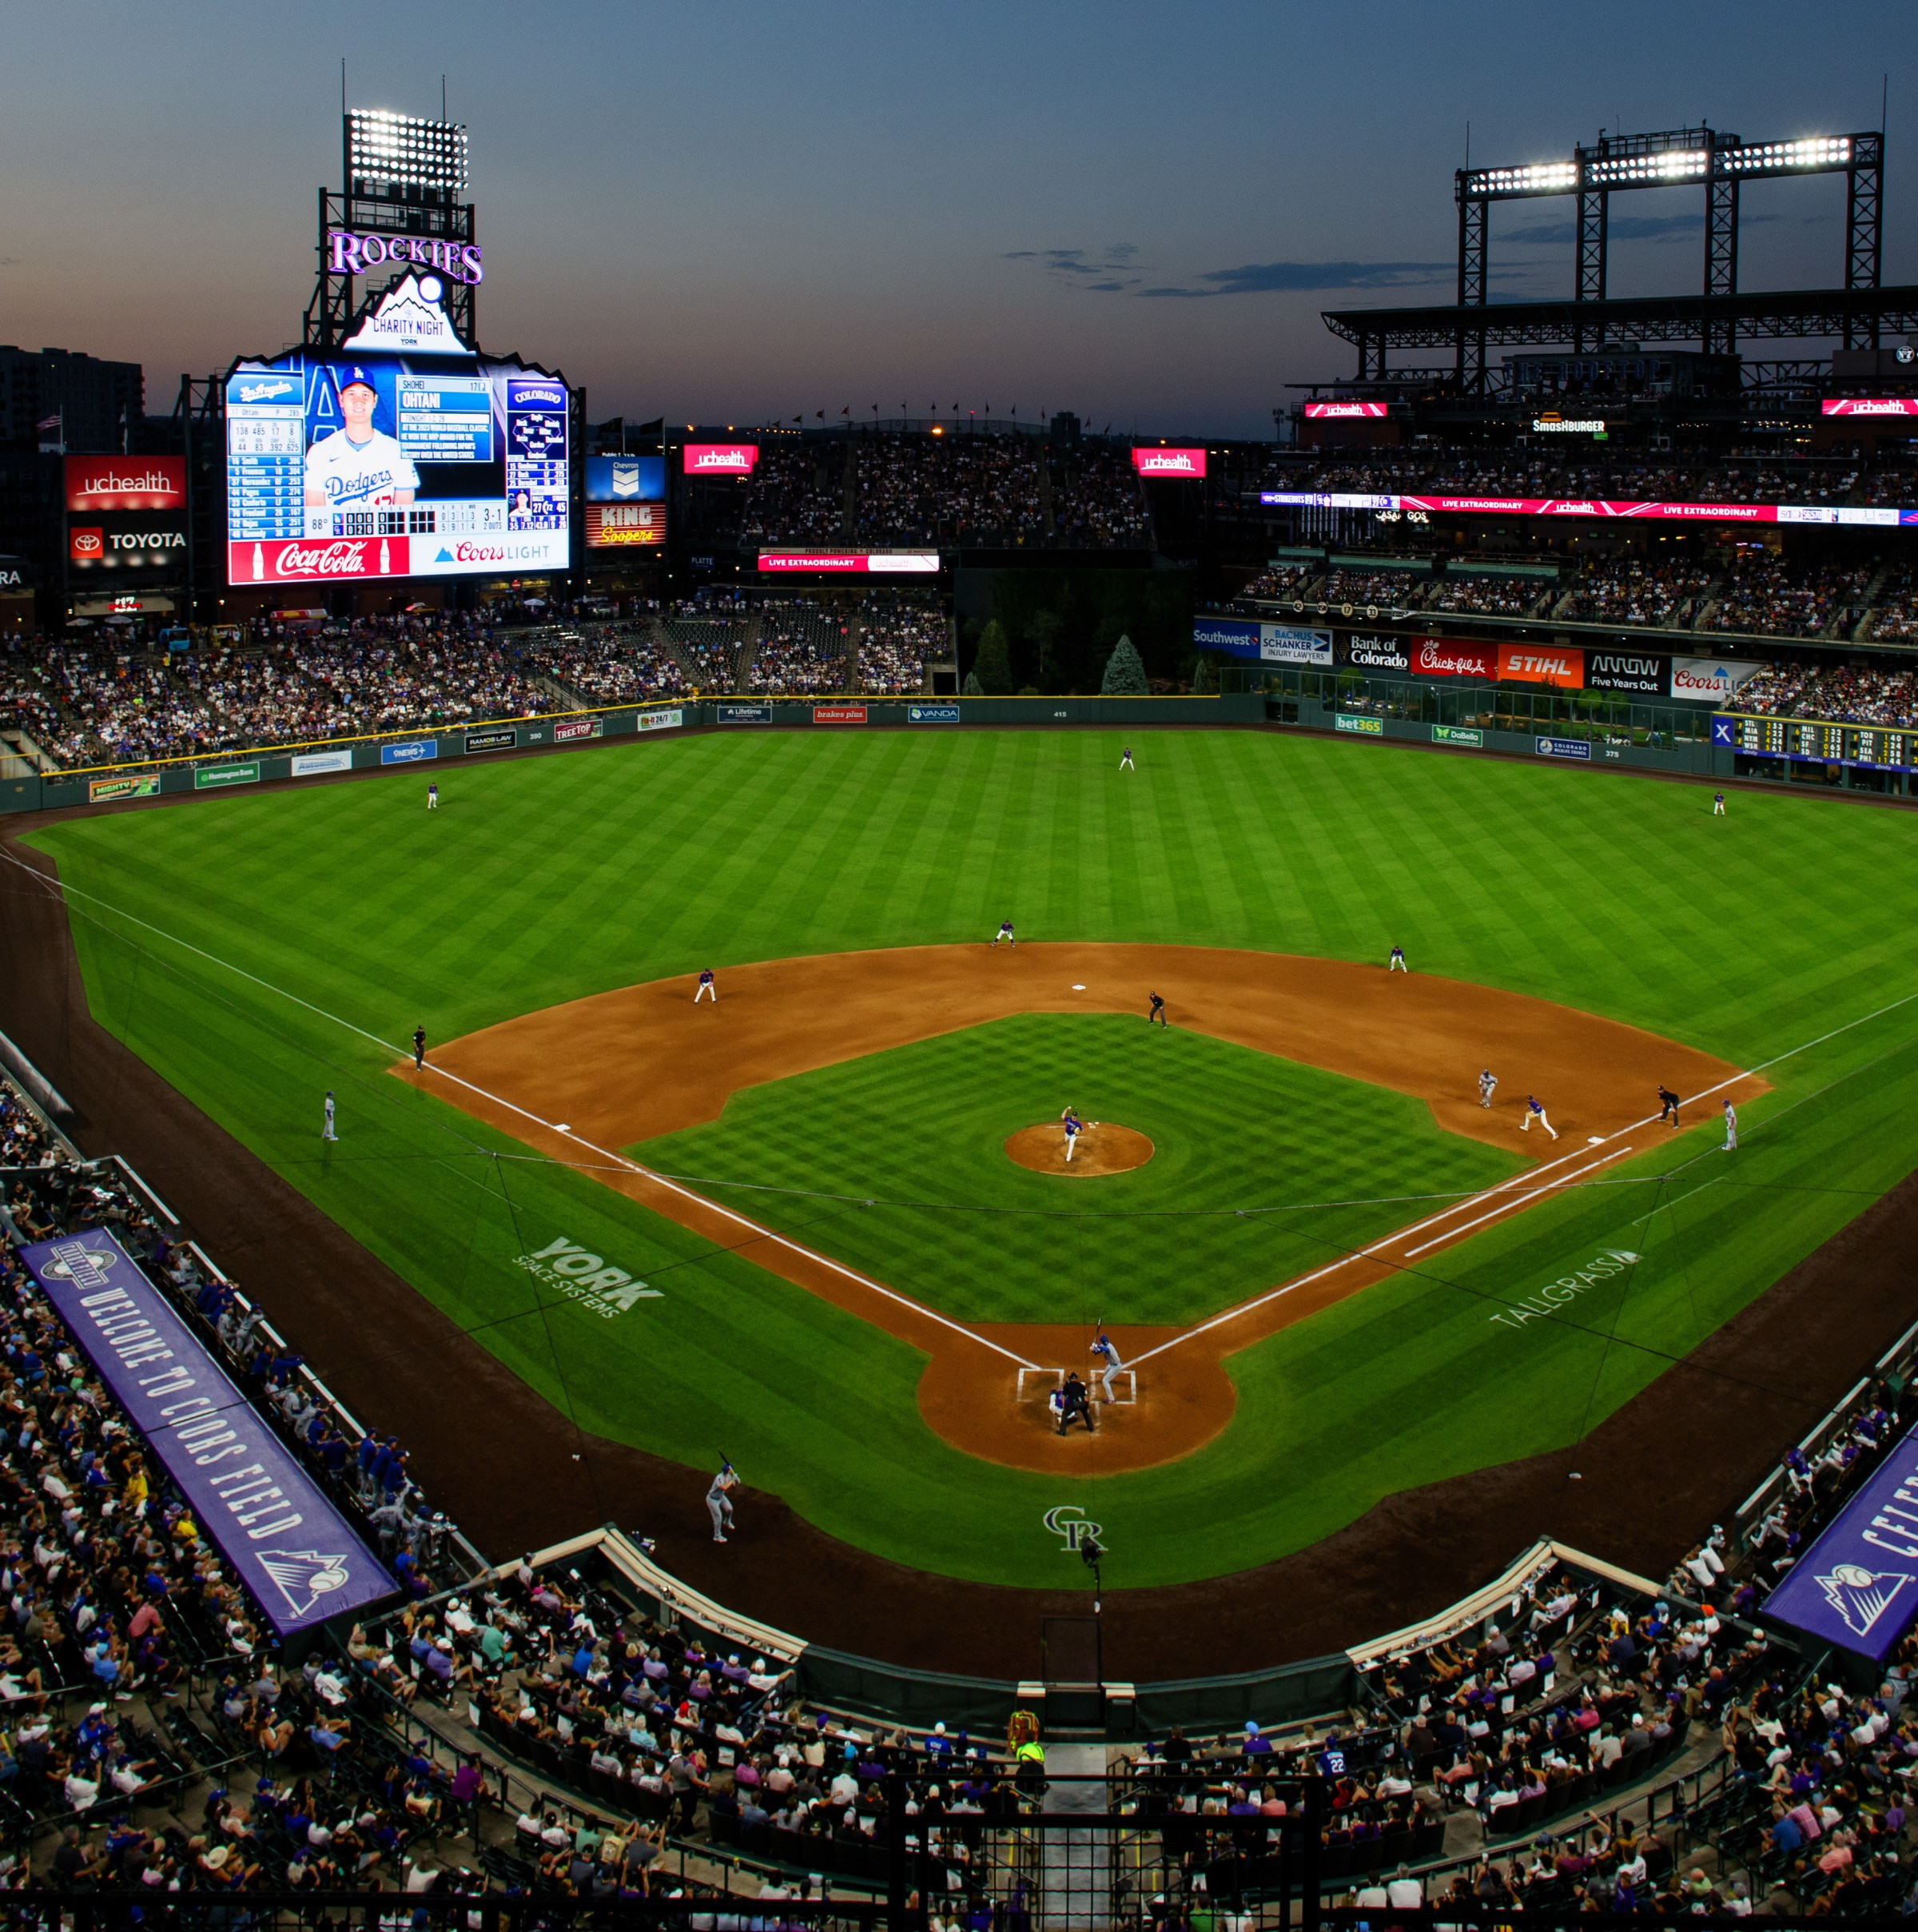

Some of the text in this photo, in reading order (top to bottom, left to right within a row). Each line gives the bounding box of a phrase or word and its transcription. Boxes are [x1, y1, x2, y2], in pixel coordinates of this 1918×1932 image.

[328, 232, 483, 285] ROCKIES
[373, 318, 444, 336] CHARITY NIGHT
[403, 380, 424, 389] SHOHEI
[402, 392, 440, 408] OHTANI
[515, 390, 561, 404] COLORADO
[1853, 400, 1904, 412] uchealth
[698, 450, 745, 465] uchealth
[1145, 454, 1191, 468] uchealth
[86, 471, 169, 492] uchealth
[326, 470, 393, 501] Dodgers
[1556, 502, 1594, 512] uchealth
[1685, 508, 1757, 516] EXTRAORDINARY
[601, 507, 652, 527] KING
[109, 533, 186, 548] TOYOTA
[601, 527, 653, 545] Soopers
[276, 541, 368, 576] Coca-Cola
[456, 541, 549, 562] Coors LIGHT
[1193, 630, 1250, 645] Southwest
[1275, 630, 1312, 640] BACHUS
[1263, 639, 1311, 651] SCHANKER
[1351, 635, 1397, 651] Bank of
[1268, 649, 1324, 660] INJURY LAWYERS
[1351, 650, 1408, 667] Colorado
[1507, 655, 1572, 675] STIHL
[1592, 676, 1658, 691] Five Years Out
[1674, 670, 1721, 691] Coors
[655, 714, 668, 723] 24/7
[1337, 717, 1381, 732] bet365
[556, 723, 591, 739] TREE TOP
[1450, 731, 1478, 741] DaBella
[469, 737, 495, 746] RAMOS
[1554, 743, 1587, 751] COLORADO
[1860, 747, 1872, 755] SEA
[209, 771, 240, 779] Huntington
[96, 780, 130, 795] MIGHTY
[530, 1236, 665, 1312] YORK
[511, 1255, 620, 1319] SPACE SYSTEMS
[1489, 1257, 1625, 1328] TALLGRASS
[80, 1287, 303, 1540] WELCOME TO COORS FIELD
[1331, 1759, 1344, 1773] 22
